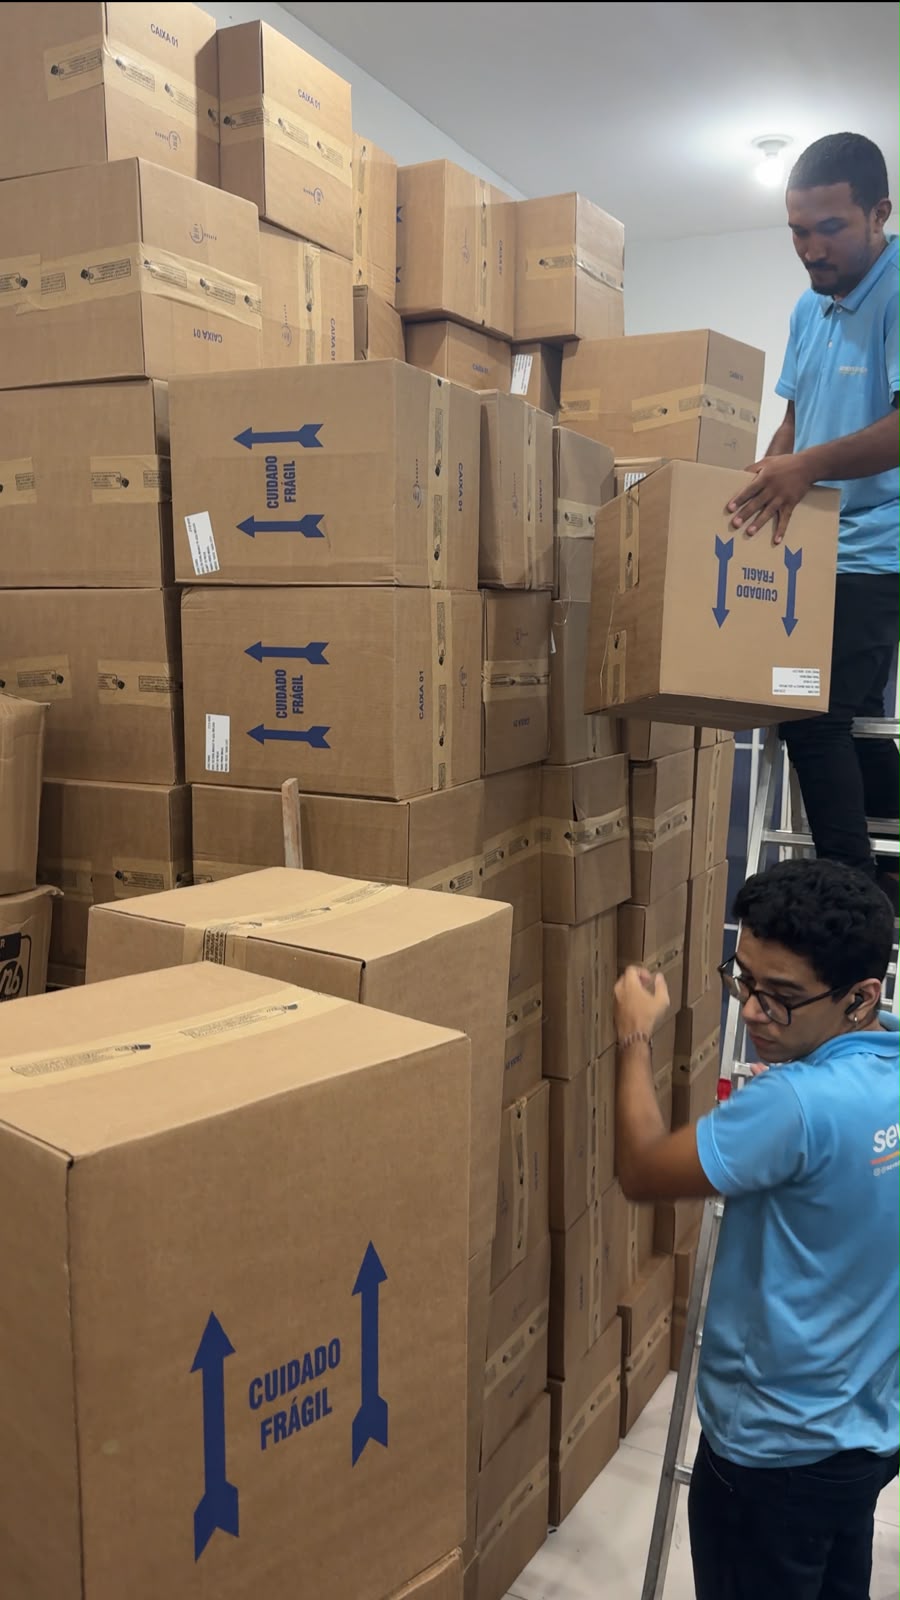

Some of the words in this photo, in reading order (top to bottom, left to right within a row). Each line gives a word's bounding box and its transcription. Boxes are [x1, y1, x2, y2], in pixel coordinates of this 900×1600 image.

[150, 23, 171, 44] CAIXA
[171, 35, 178, 48] 01
[297, 88, 314, 107] CAIXA
[314, 99, 321, 111] 01
[193, 327, 201, 339] 01
[201, 329, 223, 343] CAIXA
[330, 350, 336, 361] 01
[265, 455, 279, 509] CUIDADO
[281, 460, 296, 503] FRÁGIL
[458, 499, 463, 512] 01
[741, 567, 775, 585] FRÁGIL
[736, 584, 778, 602] CUIDADO
[418, 670, 424, 683] 01
[275, 669, 288, 719] CUIDADO
[289, 674, 304, 714] FRÁGIL
[248, 1337, 341, 1410] CUIDADO
[260, 1387, 333, 1451] FRÁGIL
